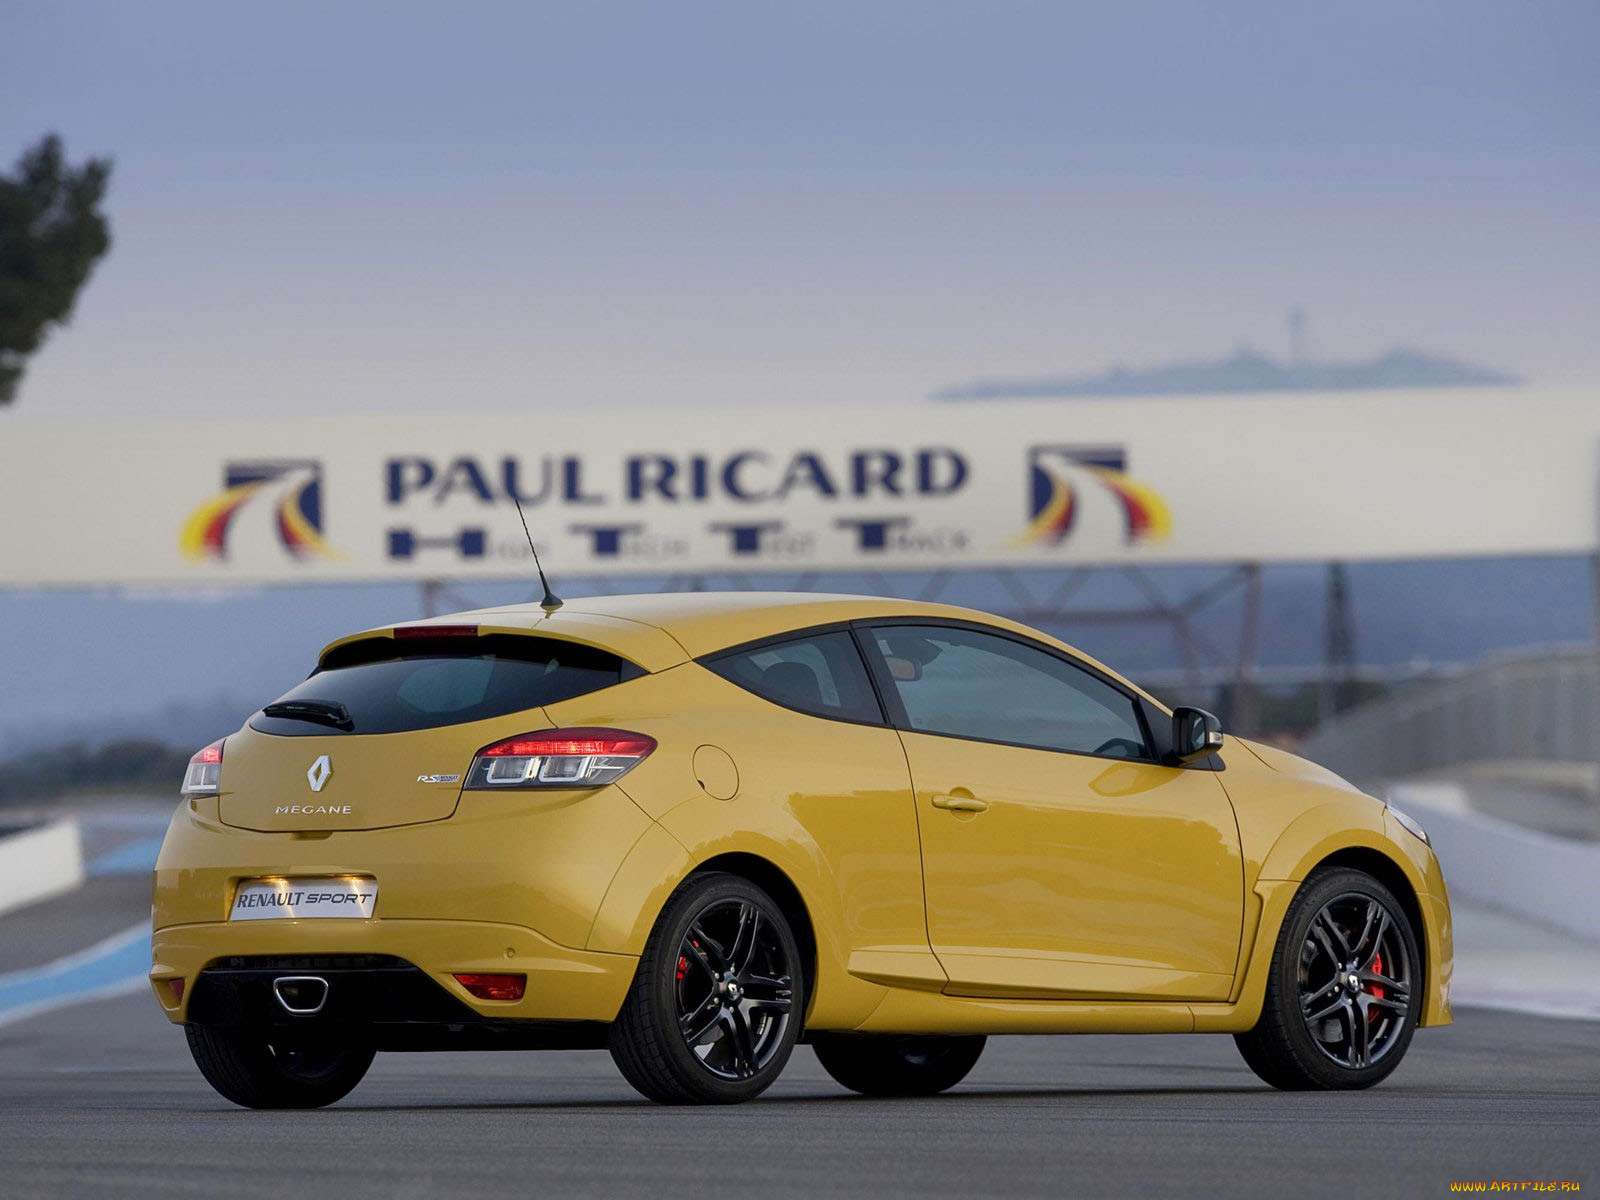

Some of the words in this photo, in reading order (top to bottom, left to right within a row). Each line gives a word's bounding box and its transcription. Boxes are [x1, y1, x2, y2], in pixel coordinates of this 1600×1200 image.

[384, 454, 605, 504] PAUL
[625, 446, 970, 503] RICARD
[274, 805, 352, 815] MEGANE
[236, 891, 305, 909] RENAULT
[305, 892, 373, 905] SPORT
